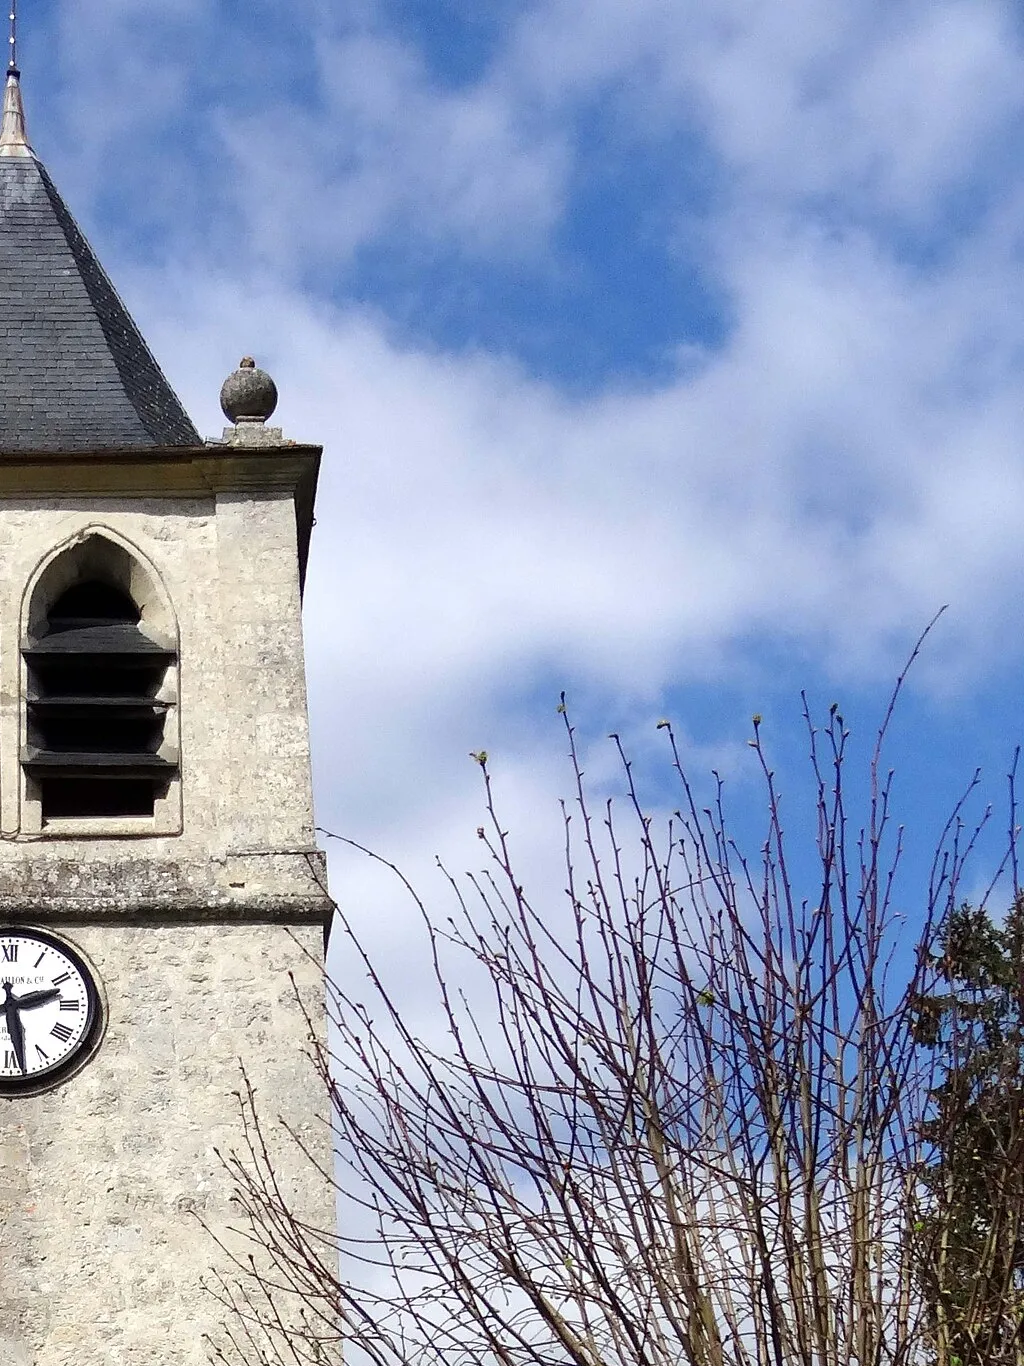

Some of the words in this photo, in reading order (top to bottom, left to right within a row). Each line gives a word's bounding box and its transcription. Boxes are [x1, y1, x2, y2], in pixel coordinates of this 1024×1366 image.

[1, 944, 19, 963] XII
[33, 952, 45, 968] I
[51, 971, 72, 986] II
[59, 999, 79, 1011] III
[49, 1021, 74, 1043] IIII
[4, 1050, 18, 1069] VI
[34, 1044, 49, 1062] V
